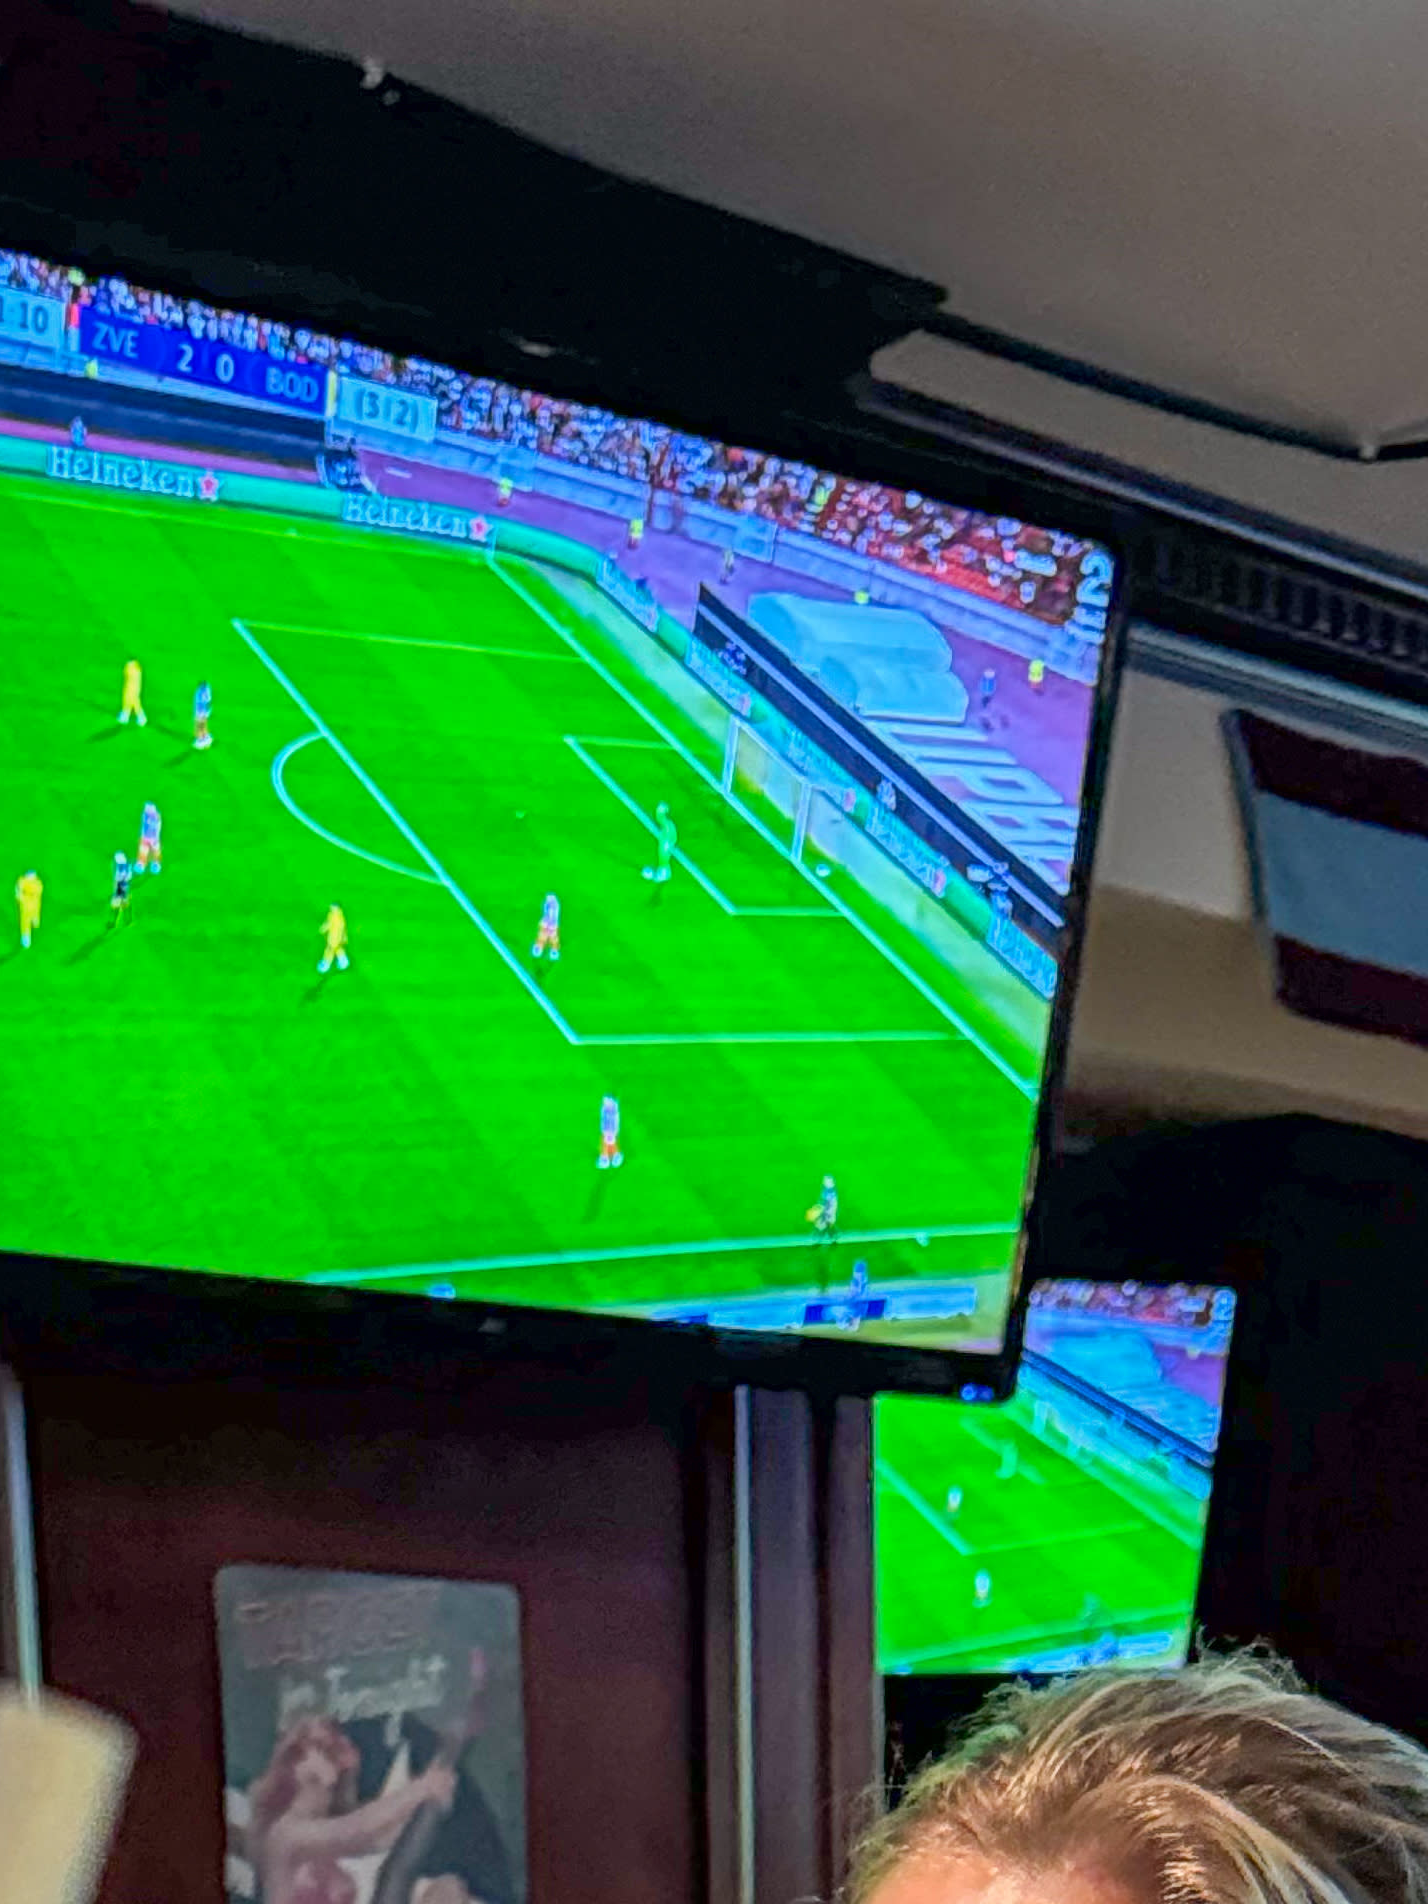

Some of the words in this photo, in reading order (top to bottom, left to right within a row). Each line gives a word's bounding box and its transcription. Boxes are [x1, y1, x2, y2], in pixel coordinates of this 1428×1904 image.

[92, 321, 139, 358] ZVE
[177, 344, 193, 372] 2
[215, 353, 235, 383] 0
[266, 366, 320, 403] BOD
[47, 445, 194, 498] Heineken
